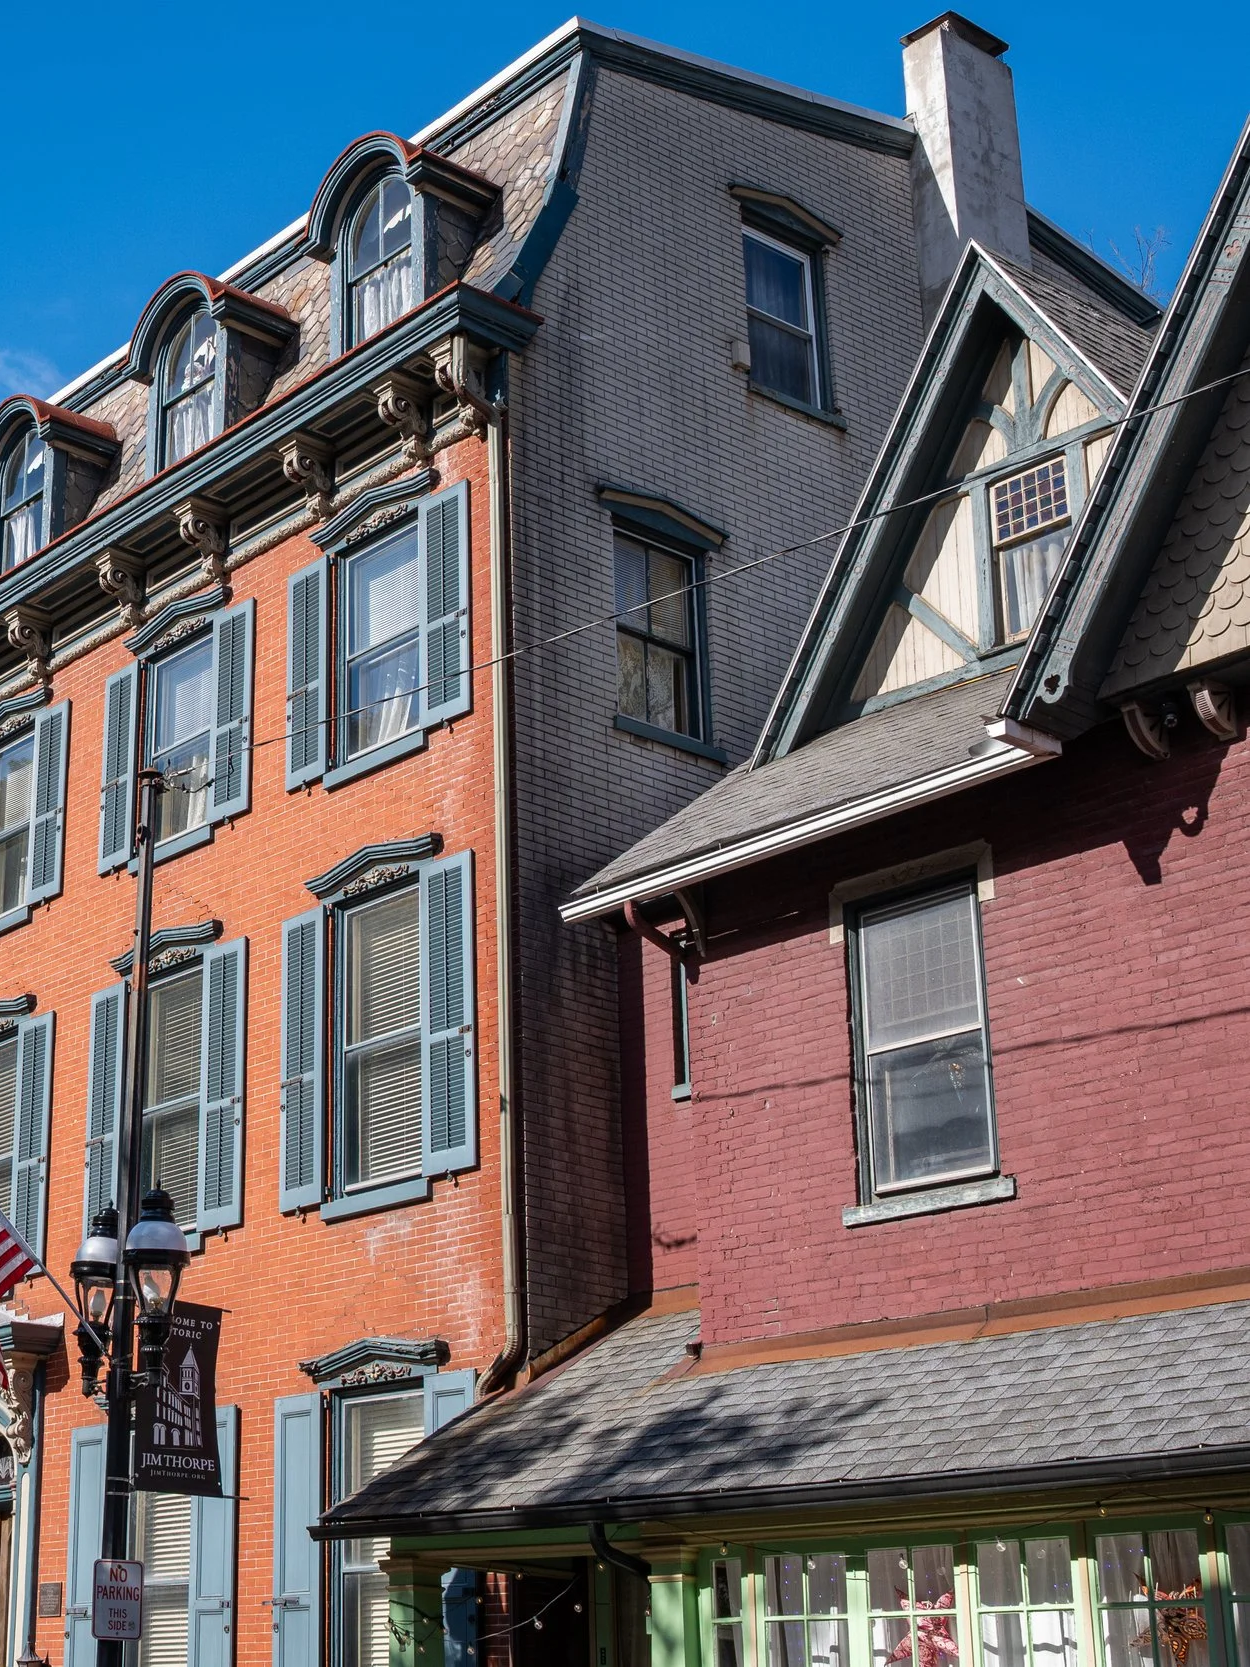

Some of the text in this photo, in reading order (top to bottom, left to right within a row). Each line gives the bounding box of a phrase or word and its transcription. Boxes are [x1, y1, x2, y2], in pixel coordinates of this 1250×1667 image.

[200, 1320, 213, 1330] TO
[140, 1452, 216, 1472] JIM THORPE
[109, 1567, 128, 1583] NO
[96, 1585, 140, 1602] PARKING
[108, 1607, 128, 1619] THIS
[107, 1619, 127, 1631] SIDE
